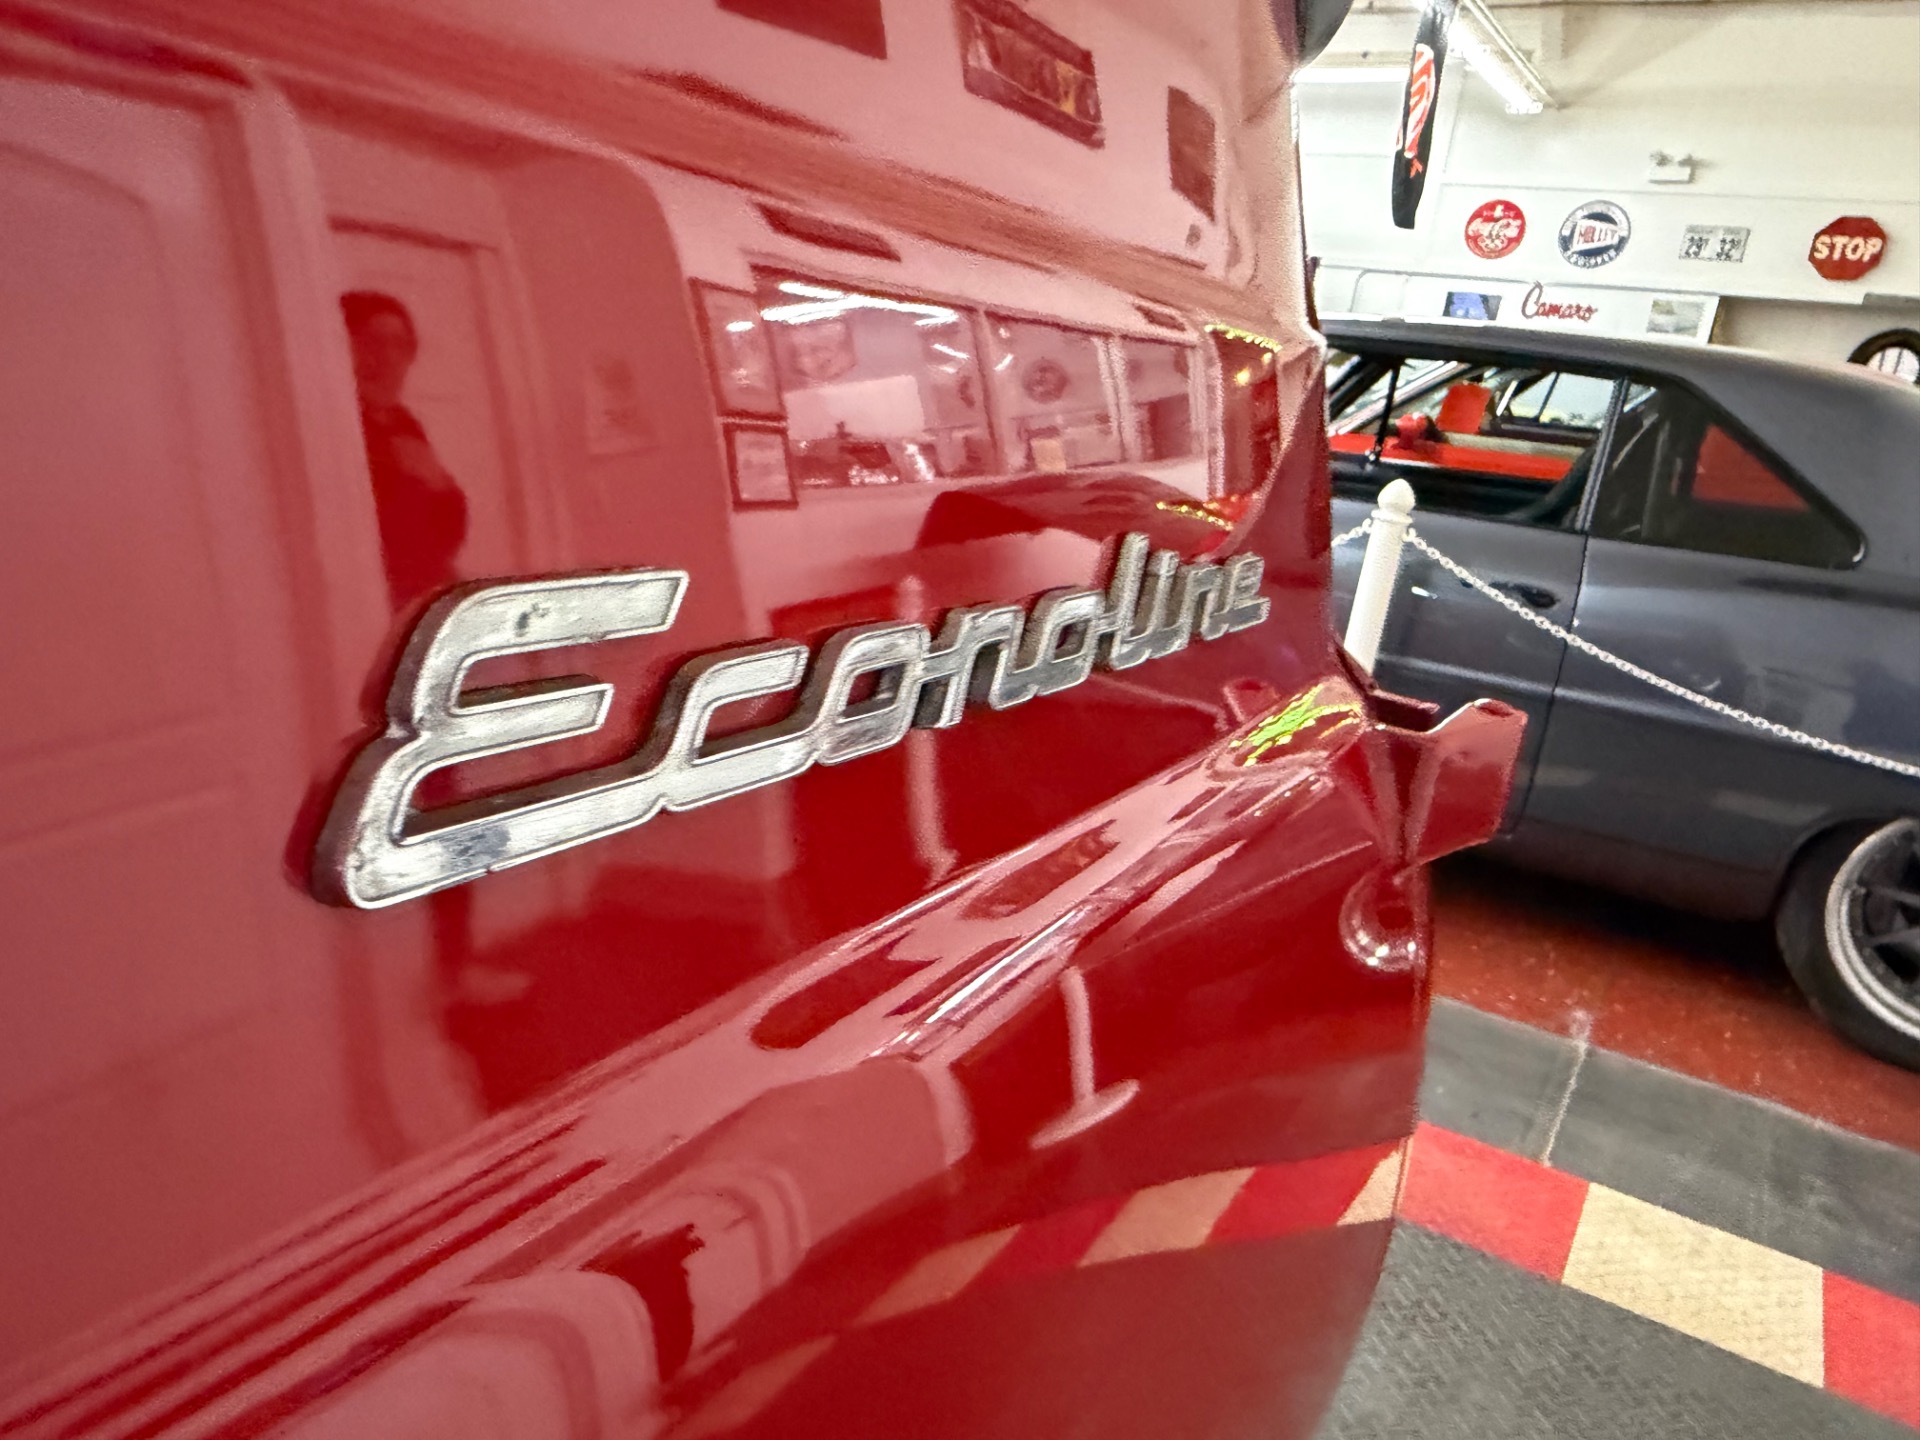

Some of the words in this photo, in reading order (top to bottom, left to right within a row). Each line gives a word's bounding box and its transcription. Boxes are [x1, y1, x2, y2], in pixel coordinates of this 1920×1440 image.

[1813, 234, 1883, 262] STOP
[1521, 280, 1598, 322] Camaro
[312, 532, 1272, 909] Econoline
